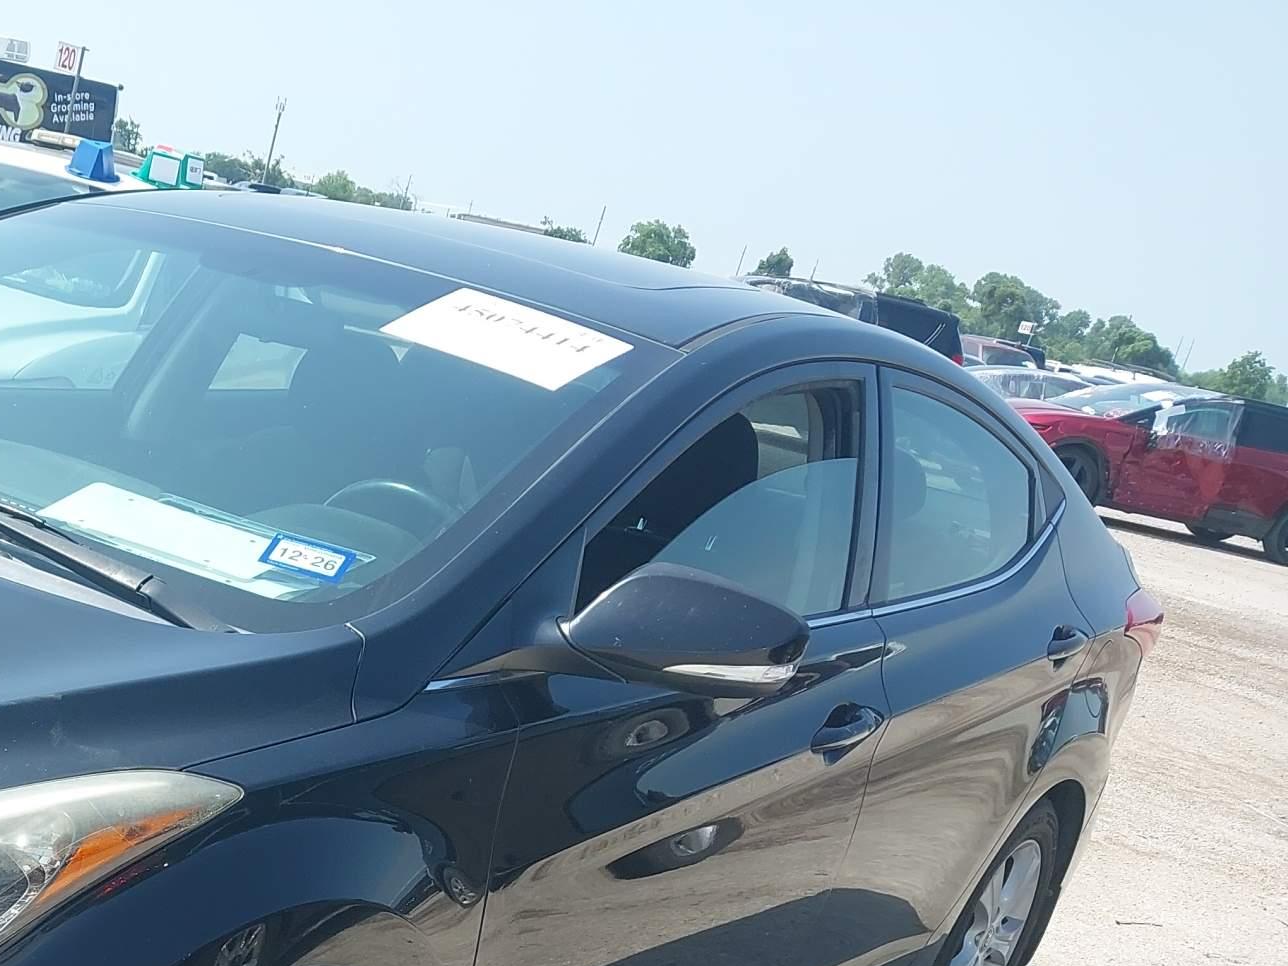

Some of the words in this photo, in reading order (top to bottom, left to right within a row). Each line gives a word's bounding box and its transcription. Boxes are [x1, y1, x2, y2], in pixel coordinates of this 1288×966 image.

[58, 44, 76, 71] 120
[54, 91, 90, 102] In-sore
[52, 111, 94, 124] Avalable
[279, 547, 303, 562] 12
[309, 556, 338, 571] 26
